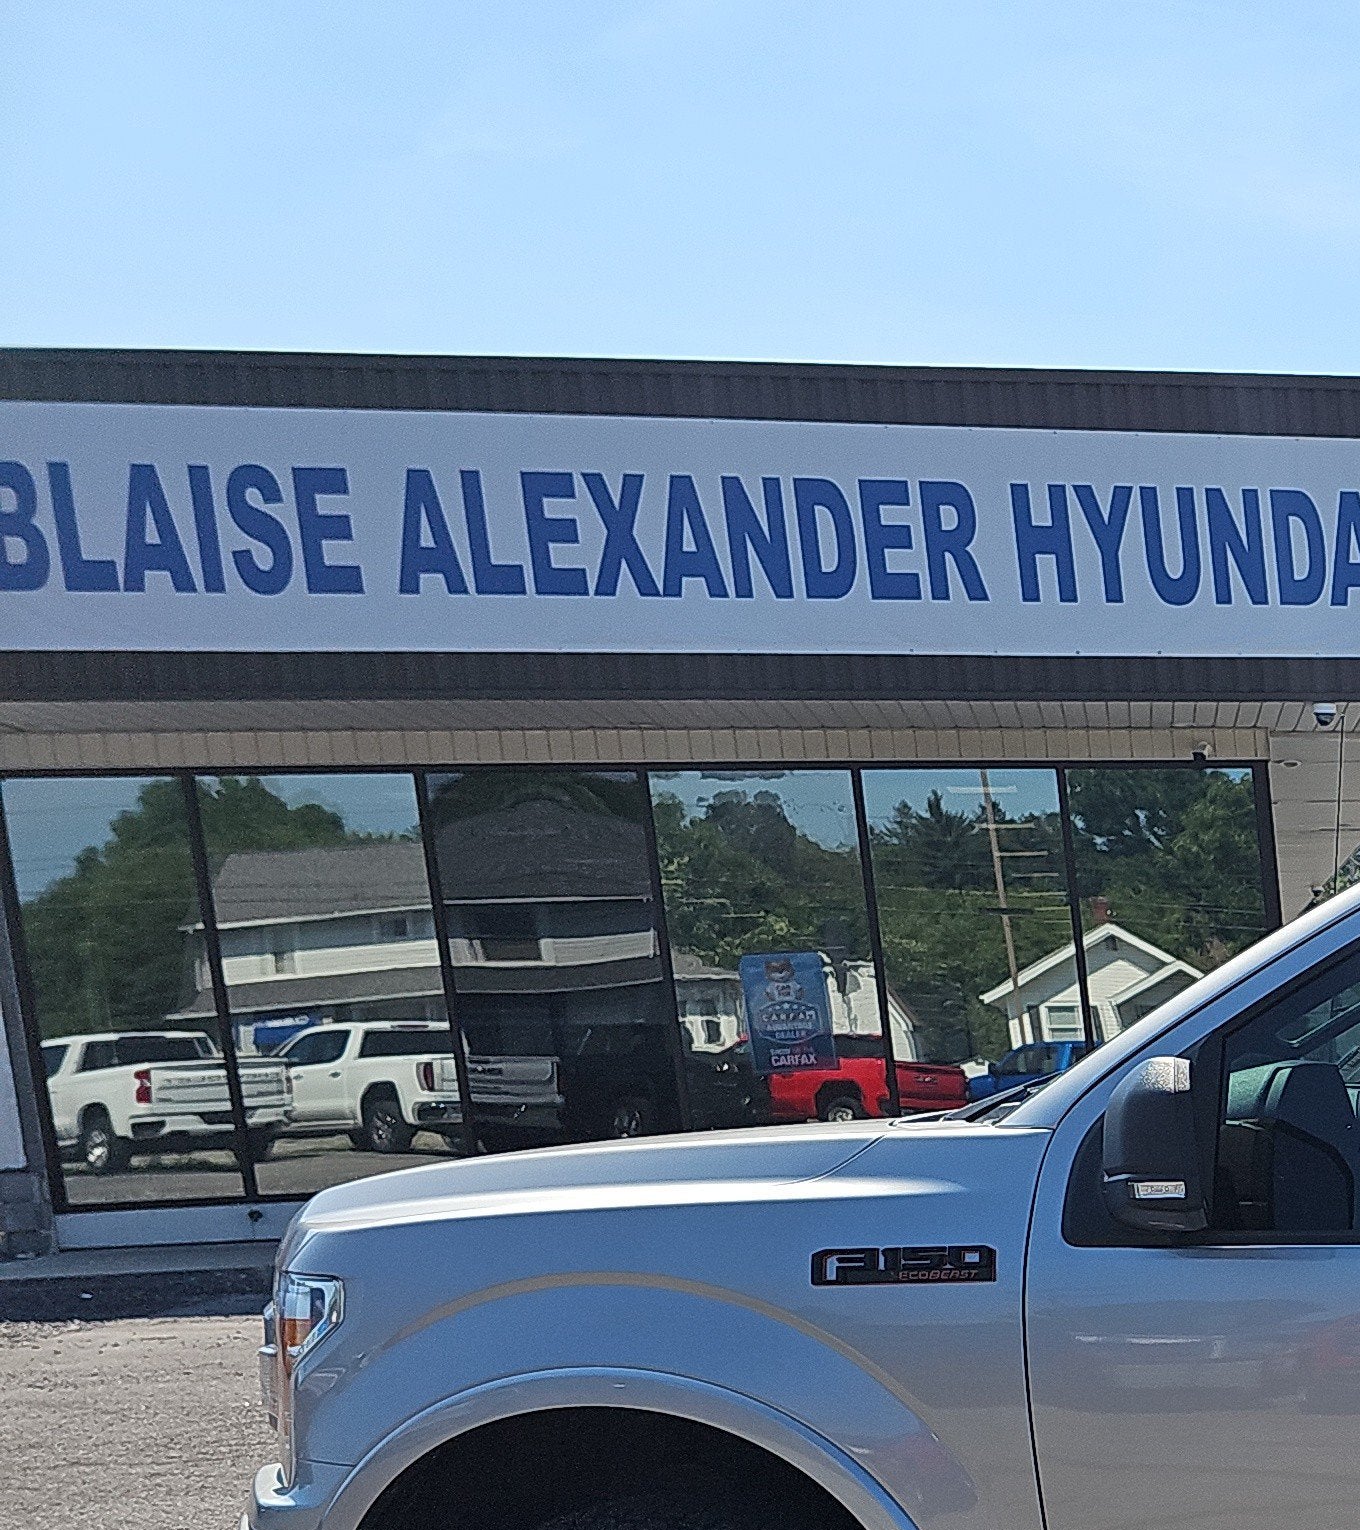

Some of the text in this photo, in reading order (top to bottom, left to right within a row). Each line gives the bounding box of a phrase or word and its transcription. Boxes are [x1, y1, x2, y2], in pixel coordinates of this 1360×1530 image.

[0, 460, 364, 595] BLAISE
[400, 467, 989, 601] ALEXANDER
[771, 1053, 817, 1066] CARFAX
